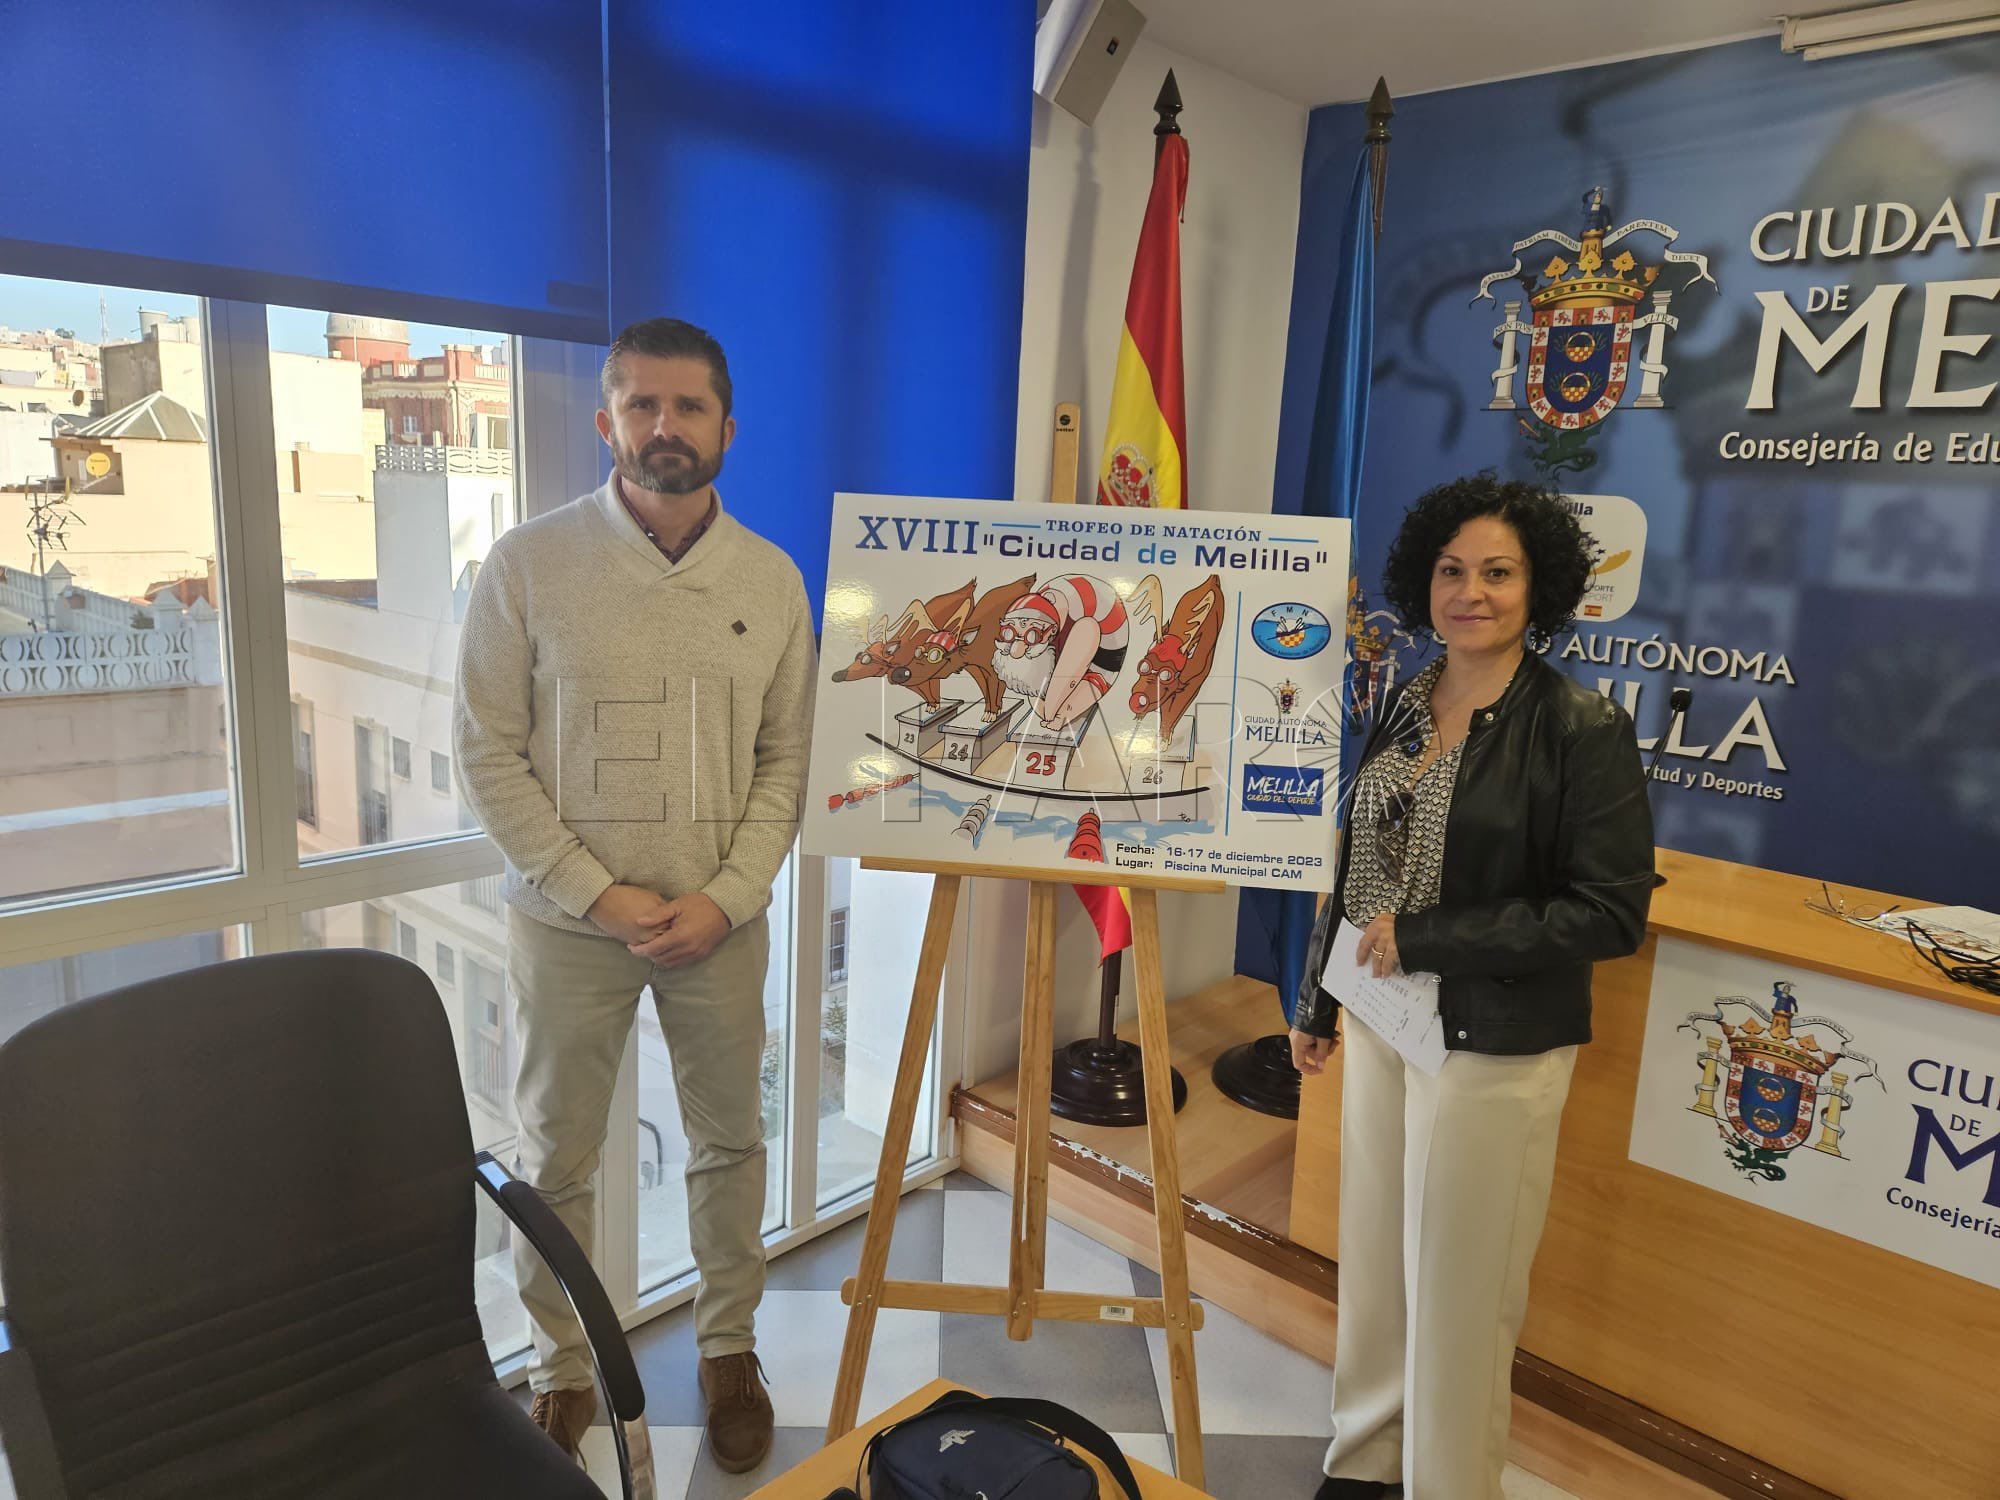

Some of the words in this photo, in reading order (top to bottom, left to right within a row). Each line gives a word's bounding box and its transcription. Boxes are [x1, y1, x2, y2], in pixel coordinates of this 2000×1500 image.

[1806, 285, 1850, 312] DE
[1719, 431, 1880, 467] Consejería
[1893, 432, 1932, 462] de
[1046, 519, 1123, 535] TROFEO
[1130, 523, 1155, 537] DE
[1163, 525, 1262, 542] NATACIÓN
[855, 515, 980, 555] XVIII
[983, 533, 1120, 562] "Ciudad
[1137, 542, 1177, 565] de
[1195, 545, 1328, 573] Melilla"
[1560, 633, 1796, 685] AUTÓNOMA
[1244, 715, 1275, 725] CIUDAD
[903, 732, 915, 745] 23
[1246, 725, 1327, 745] MELILLA
[948, 742, 969, 762] 24
[1025, 751, 1057, 776] 25
[1143, 766, 1164, 785] 26
[1247, 776, 1320, 797] MELILLA
[1684, 772, 1697, 788] y
[1701, 771, 1783, 800] Deportes
[1116, 843, 1155, 856] Fecha:
[1166, 846, 1204, 859] 16-17
[1208, 850, 1222, 860] de
[1226, 851, 1284, 865] diciembre
[1288, 855, 1322, 867] 2023
[1115, 857, 1153, 870] Lugar:
[1164, 860, 1207, 873] Piscina
[1211, 863, 1267, 878] Municipal
[1271, 868, 1302, 879] CAM
[1907, 1058, 2000, 1111] CIU
[1949, 1113, 1982, 1138] DE
[1886, 1187, 2000, 1239] Consejería
